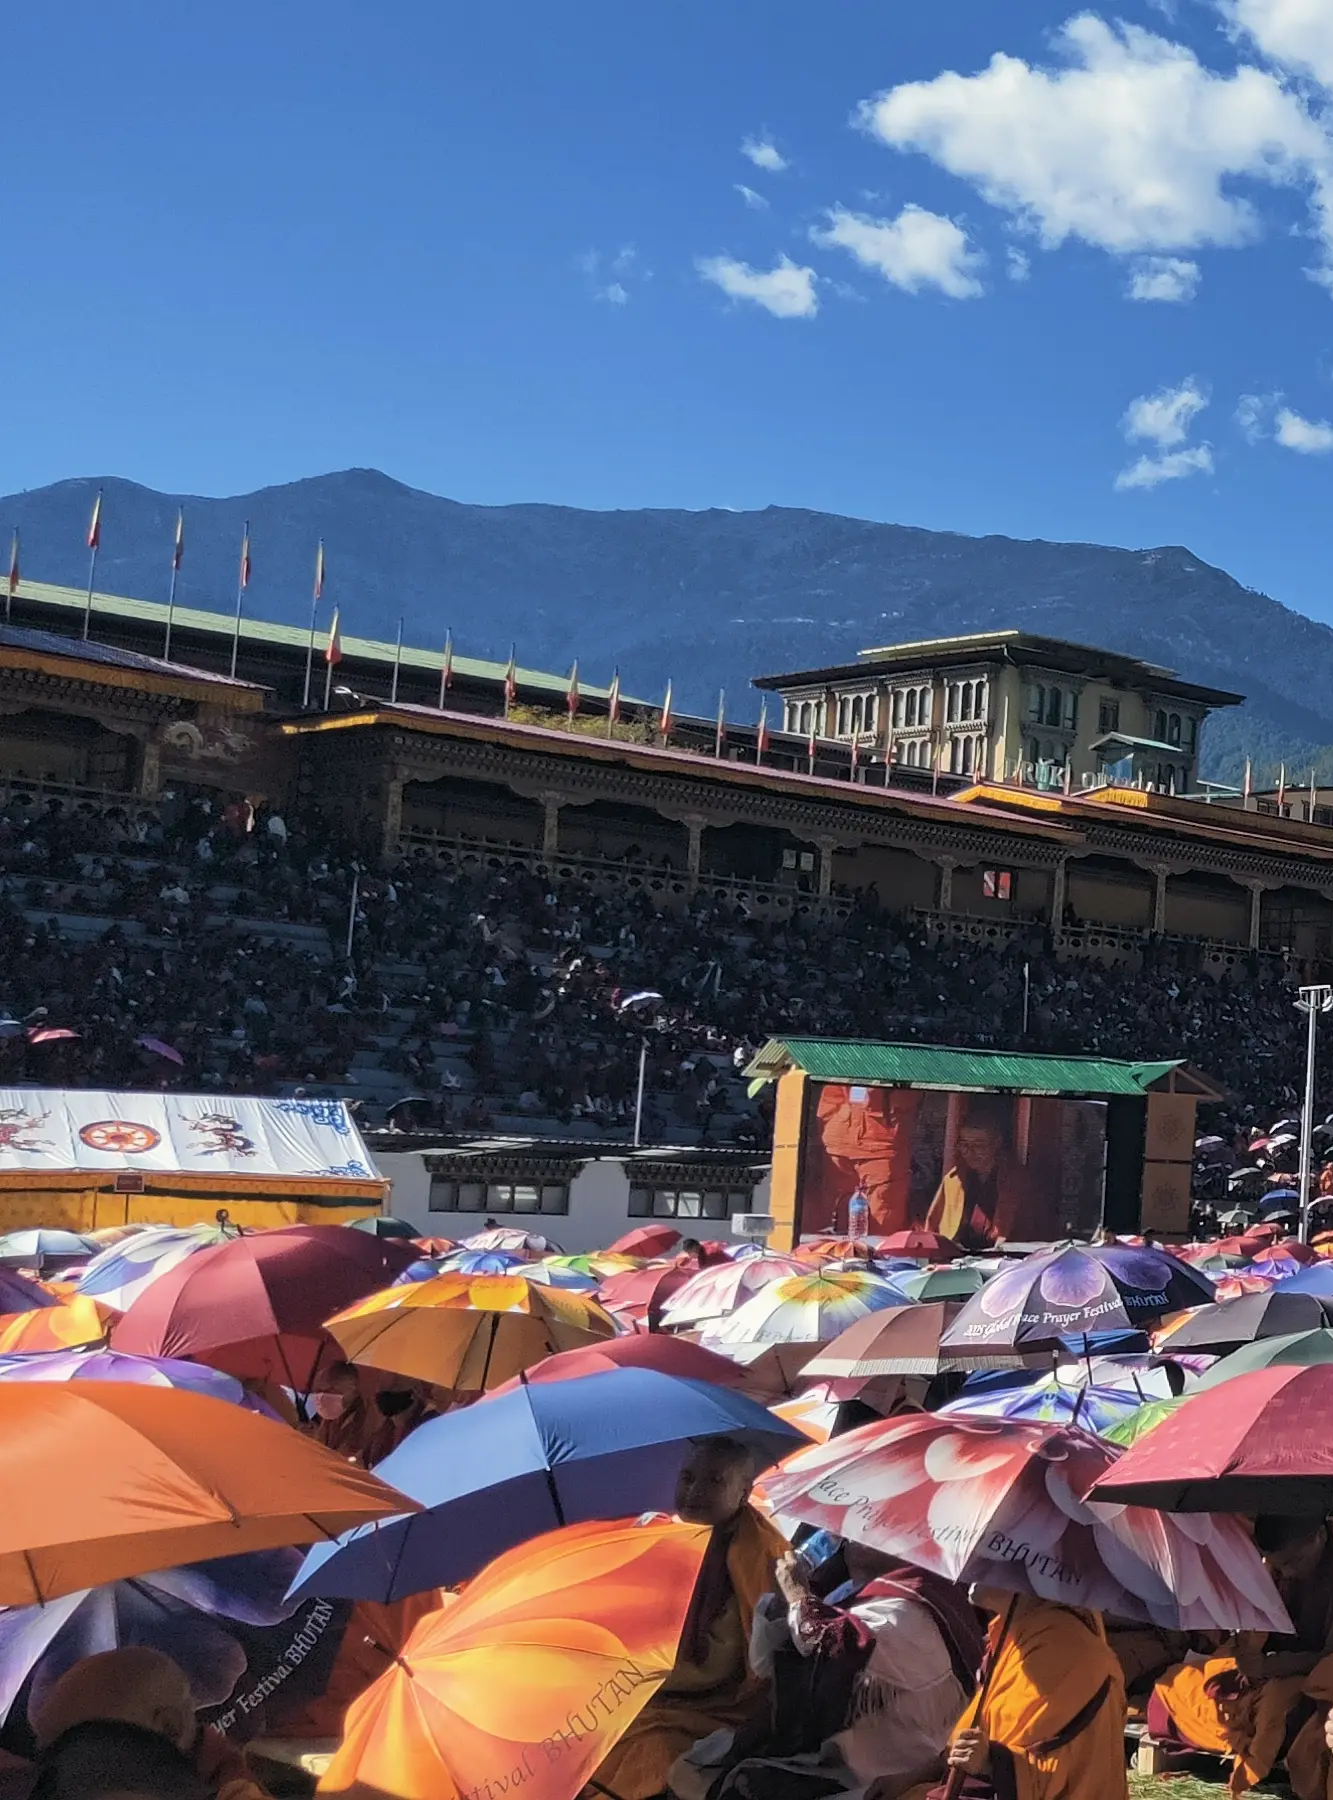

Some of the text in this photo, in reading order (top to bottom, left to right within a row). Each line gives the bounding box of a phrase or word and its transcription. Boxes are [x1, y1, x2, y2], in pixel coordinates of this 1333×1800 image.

[1043, 1311, 1081, 1327] Prayer
[1083, 1299, 1123, 1318] Festiva
[988, 1531, 1083, 1586] BHUTAN
[210, 1597, 335, 1737] yer Festival BHUTAN
[462, 1656, 646, 1800] tival BHUTAN
